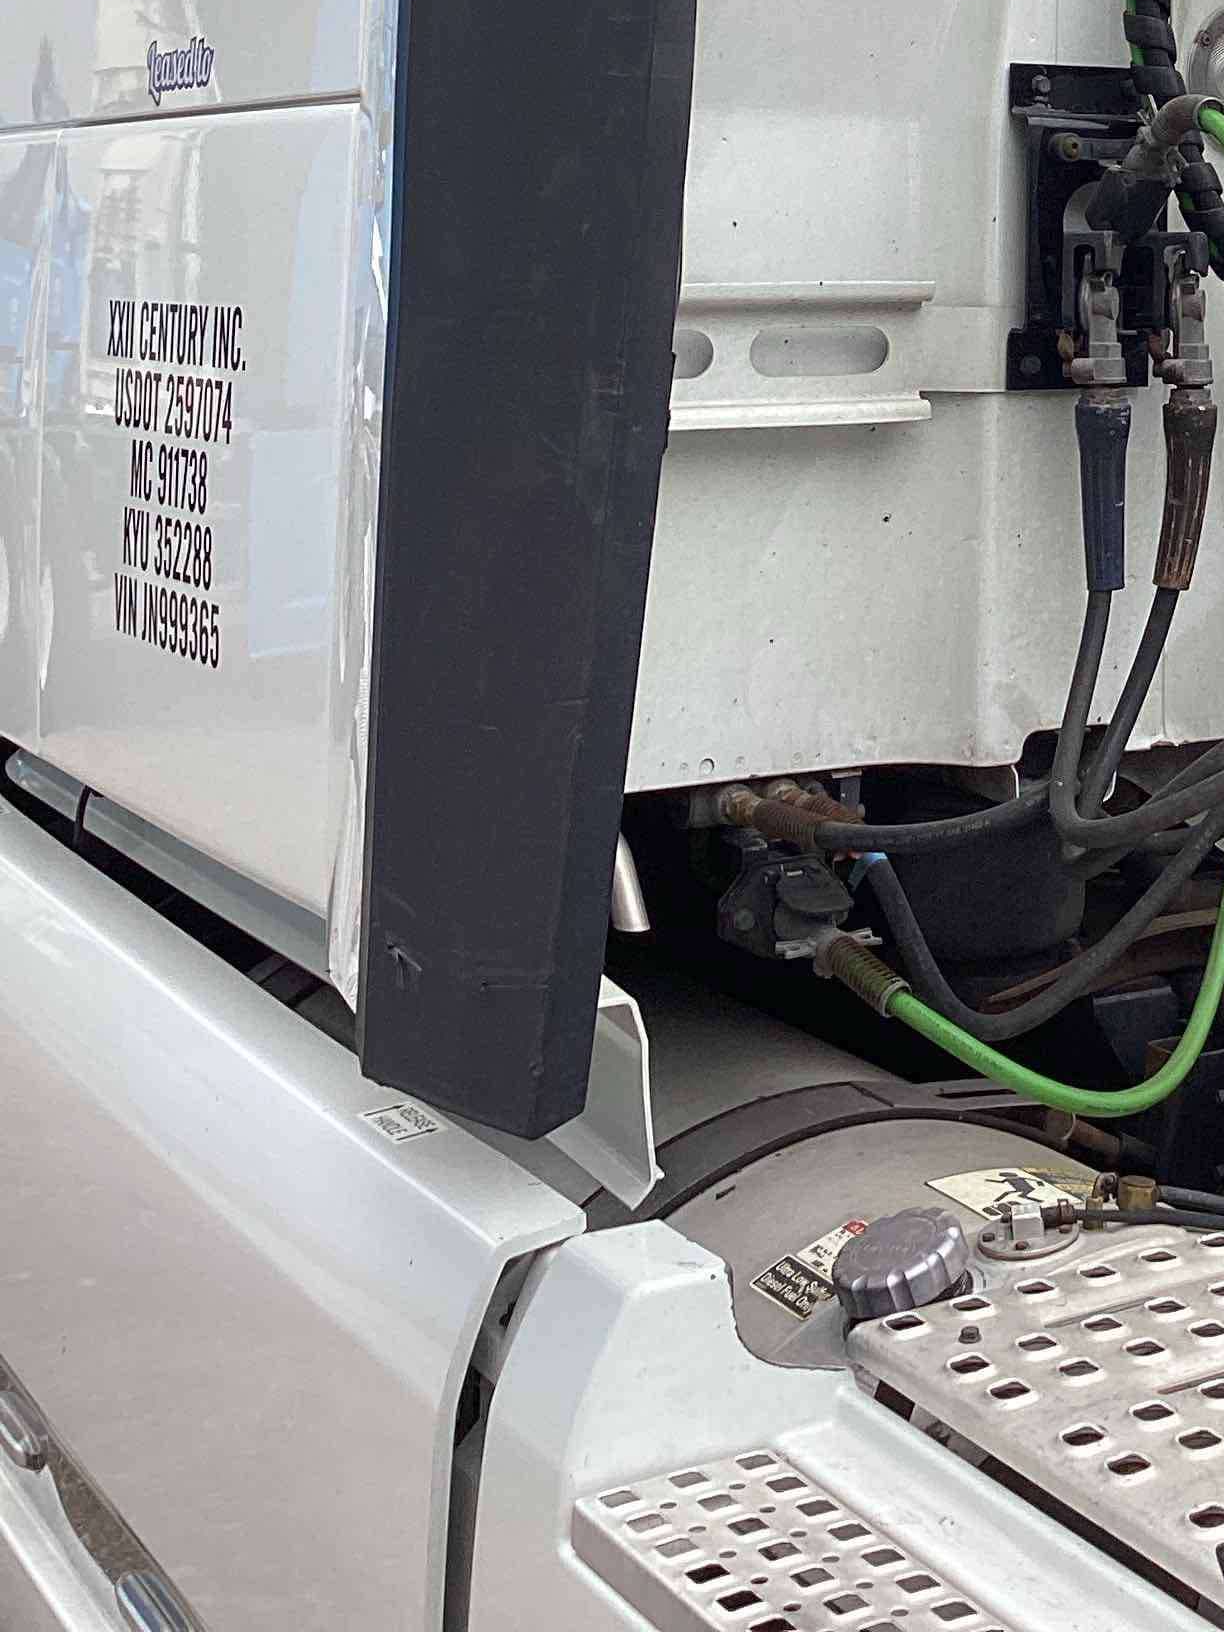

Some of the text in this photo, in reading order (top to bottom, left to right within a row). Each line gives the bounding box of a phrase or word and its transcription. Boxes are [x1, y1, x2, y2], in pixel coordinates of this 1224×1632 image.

[147, 36, 214, 106] Leased to
[107, 300, 246, 371] XXII CENTURY INC.
[115, 368, 233, 444] USDOT 2597074
[131, 439, 207, 515] MC 911738
[123, 506, 212, 591] KYU 352288
[114, 573, 220, 669] VIN JN999365
